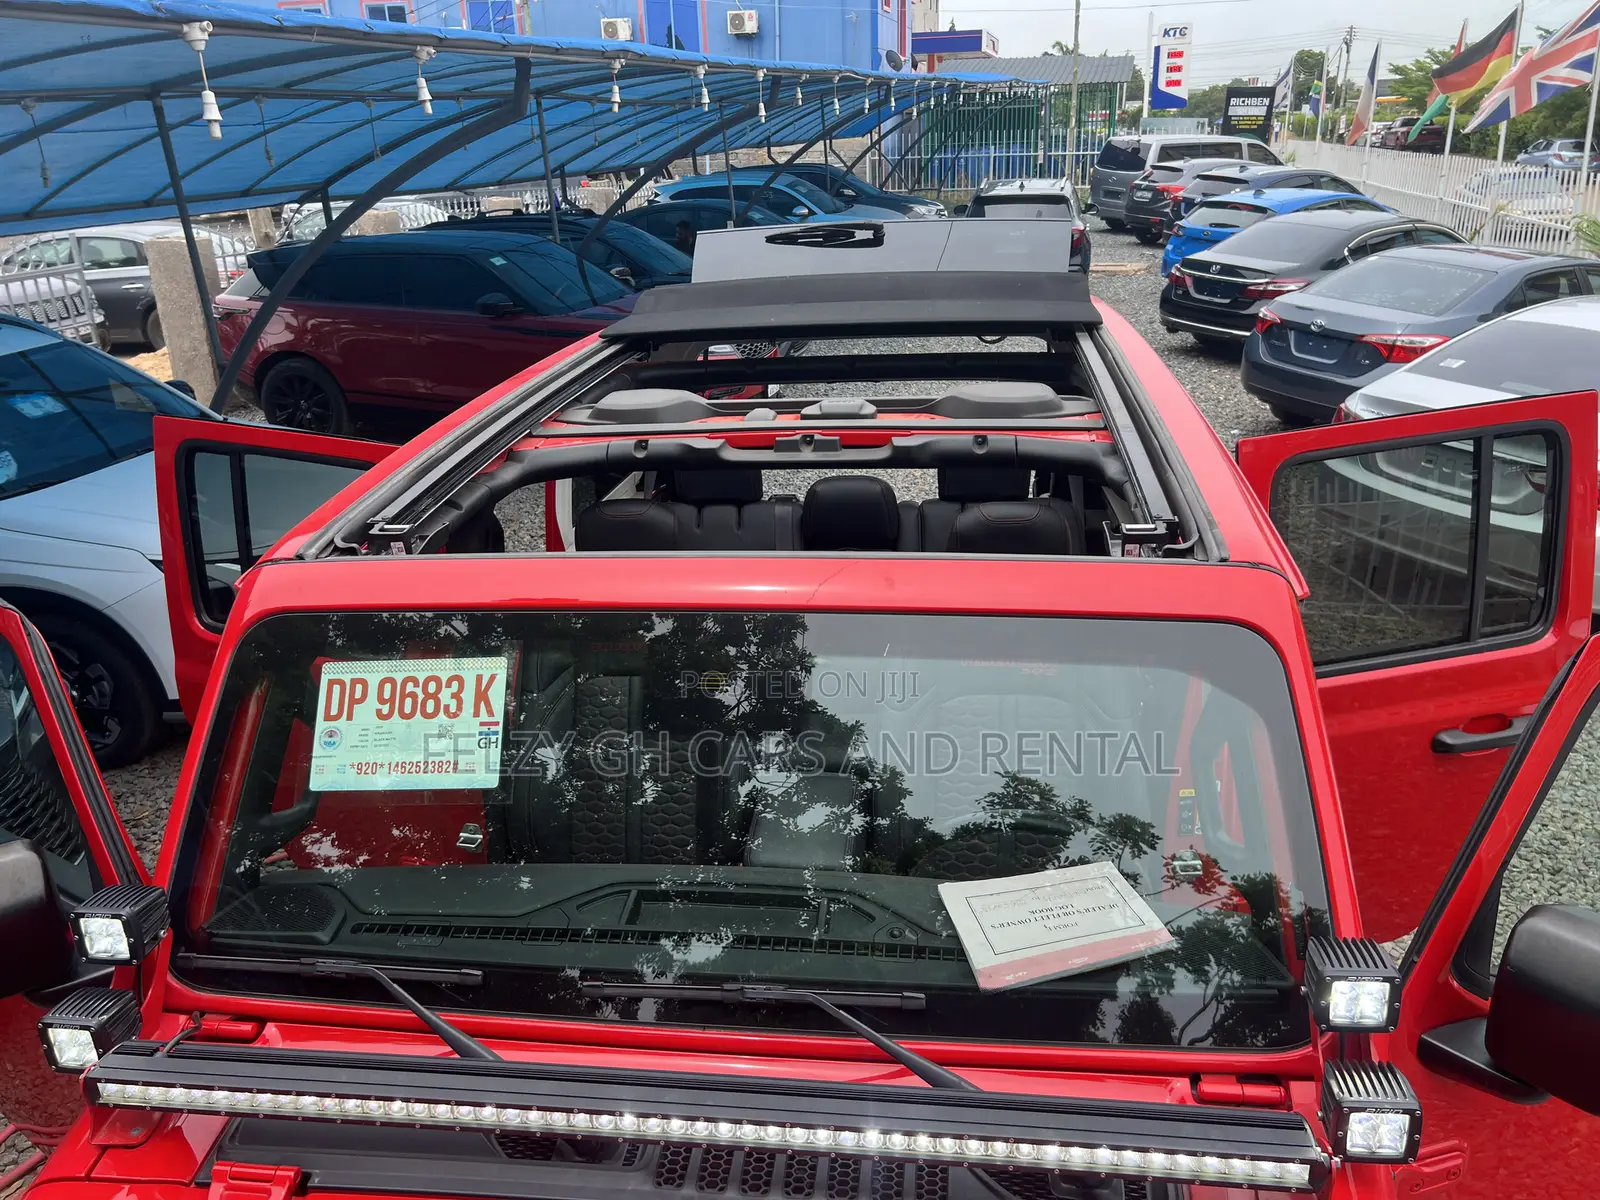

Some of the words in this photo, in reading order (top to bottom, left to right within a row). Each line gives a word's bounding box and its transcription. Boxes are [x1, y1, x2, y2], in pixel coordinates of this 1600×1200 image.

[1162, 26, 1188, 38] KTC
[1230, 97, 1270, 106] RICHBEN
[323, 677, 369, 722] DP
[375, 674, 465, 721] 9683
[472, 673, 499, 718] K
[477, 737, 499, 750] GH
[1028, 907, 1054, 915] BOOK
[1055, 903, 1075, 911] LOG
[991, 917, 1035, 929] OWNER'S
